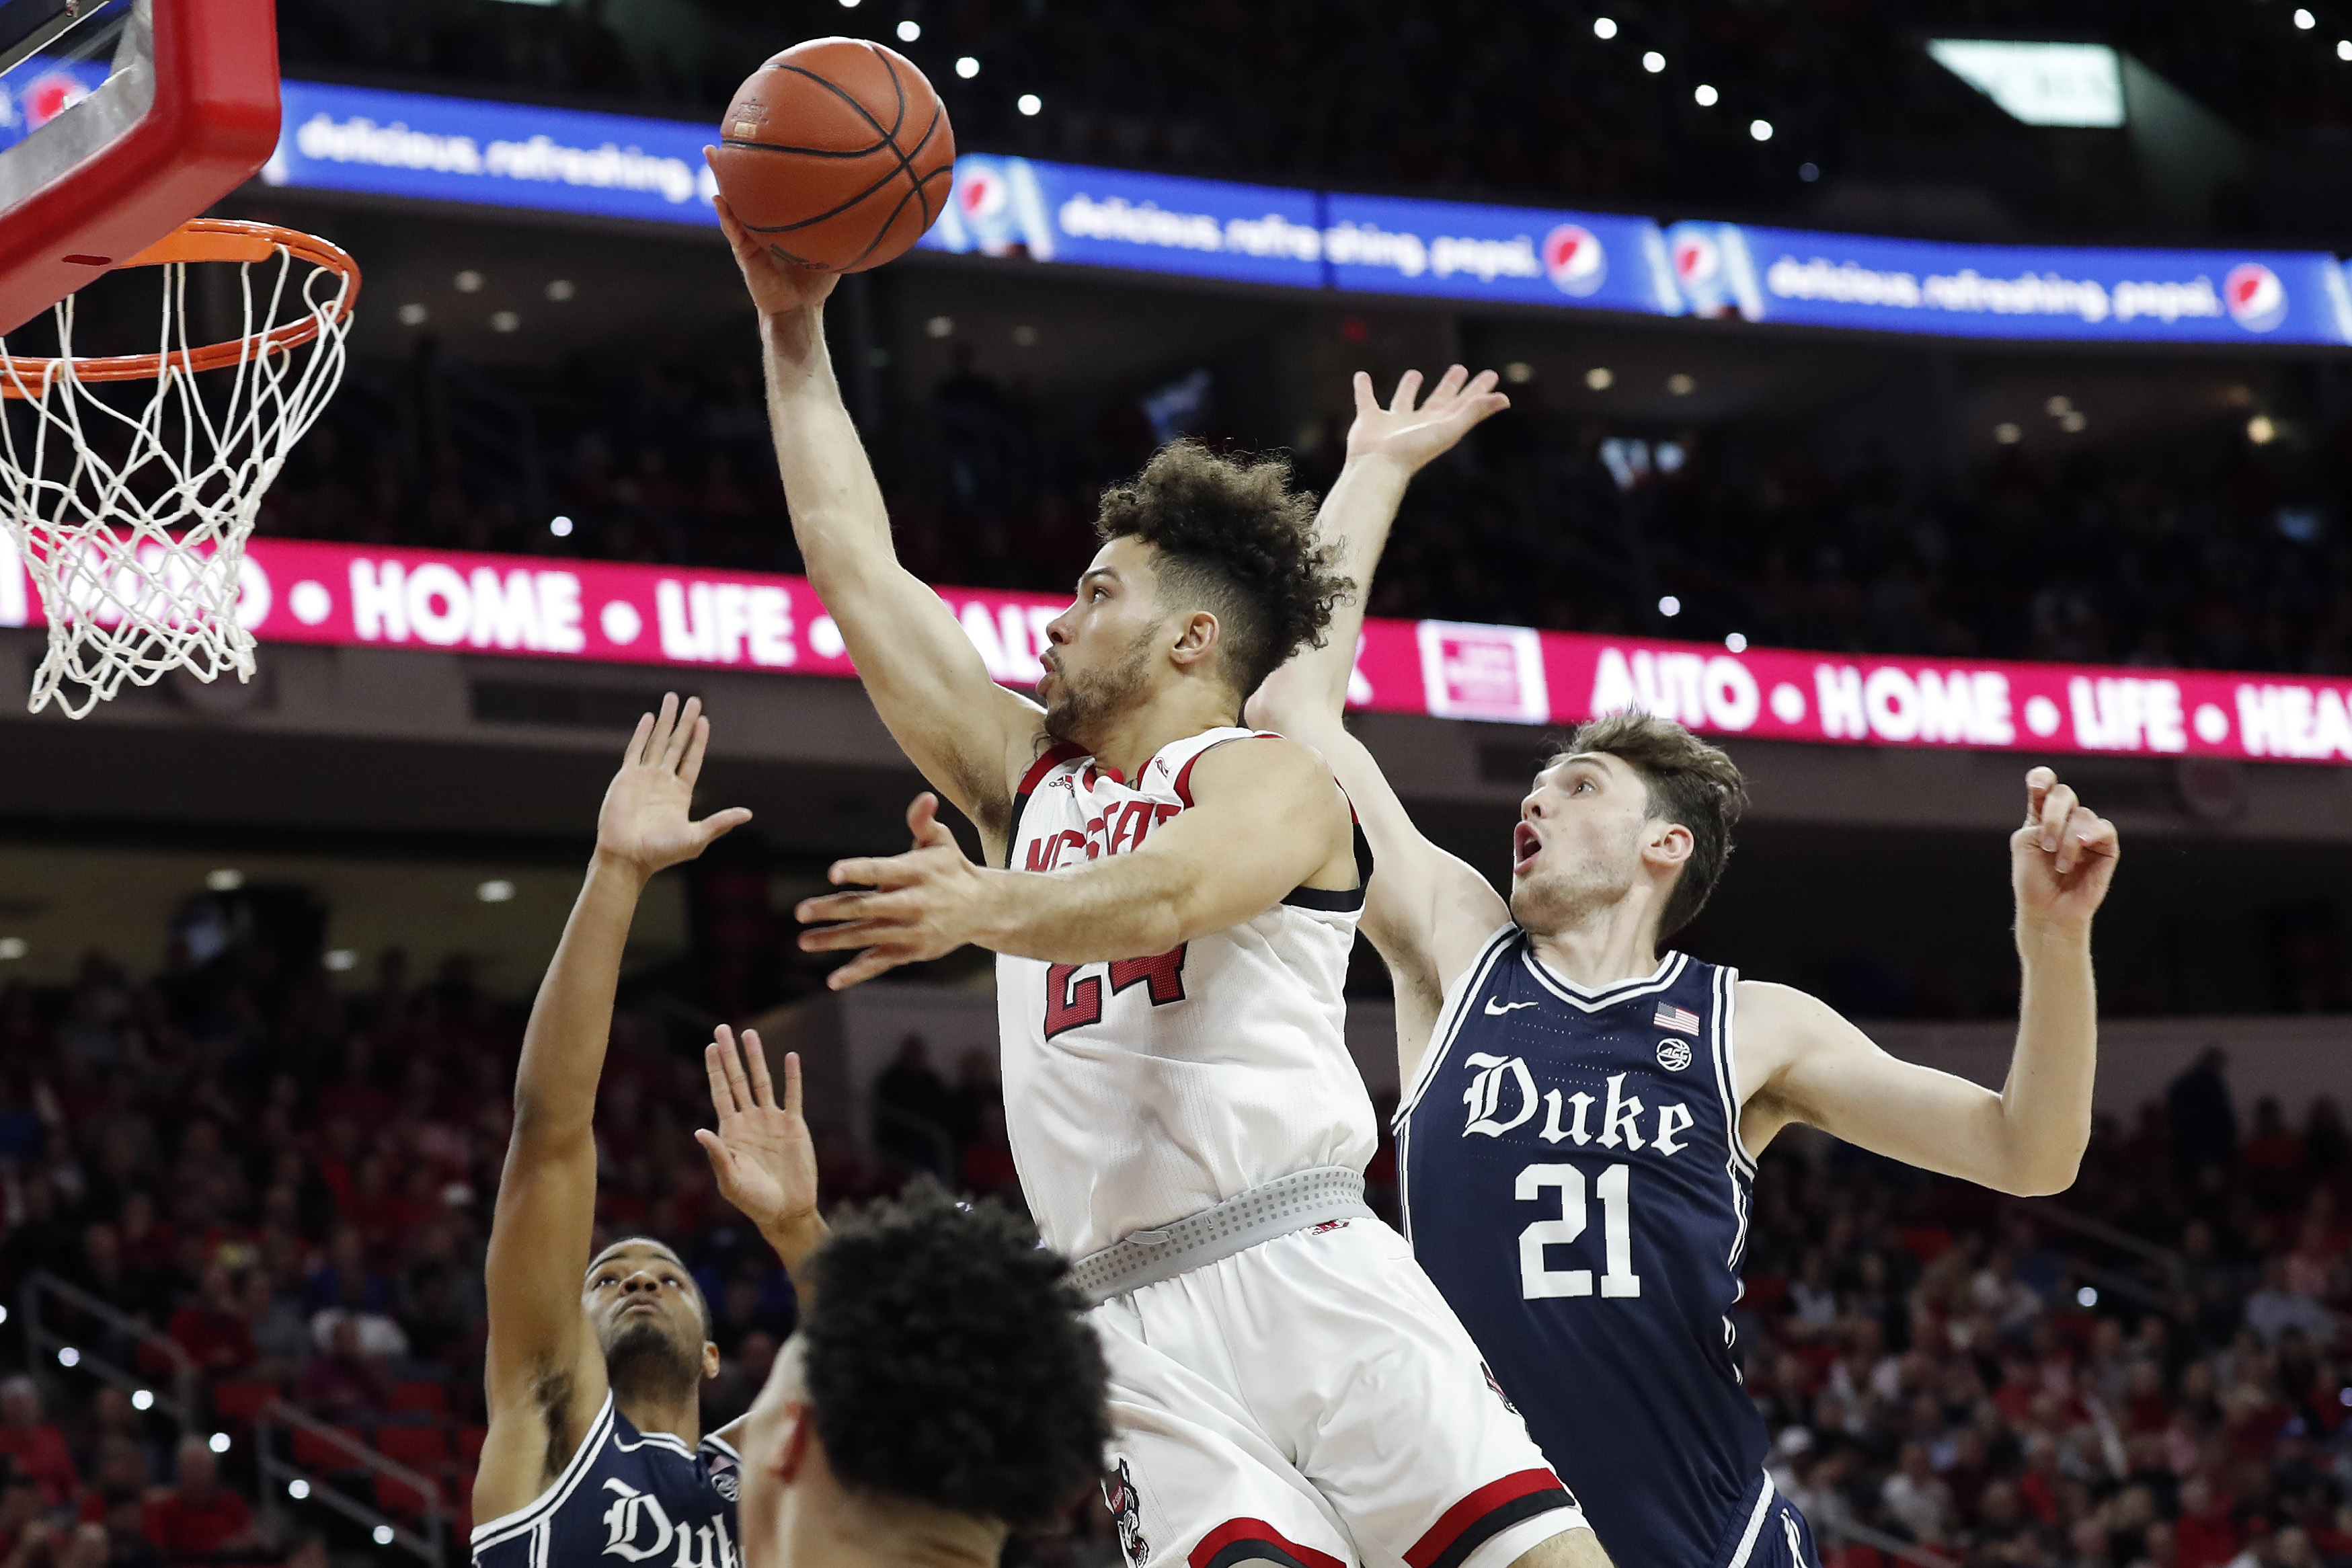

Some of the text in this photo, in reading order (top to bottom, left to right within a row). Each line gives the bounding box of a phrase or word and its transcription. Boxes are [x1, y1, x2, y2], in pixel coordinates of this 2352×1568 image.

[350, 558, 586, 653] HOME
[656, 578, 797, 666] LIFE
[1591, 647, 1759, 730] AUTO
[1815, 664, 2014, 744] HOME
[2068, 676, 2187, 752] LIFE
[2236, 683, 2352, 760] HEA
[1462, 1052, 1695, 1157] Duke
[1514, 1163, 1641, 1300] 21
[600, 1477, 744, 1568] Duk
